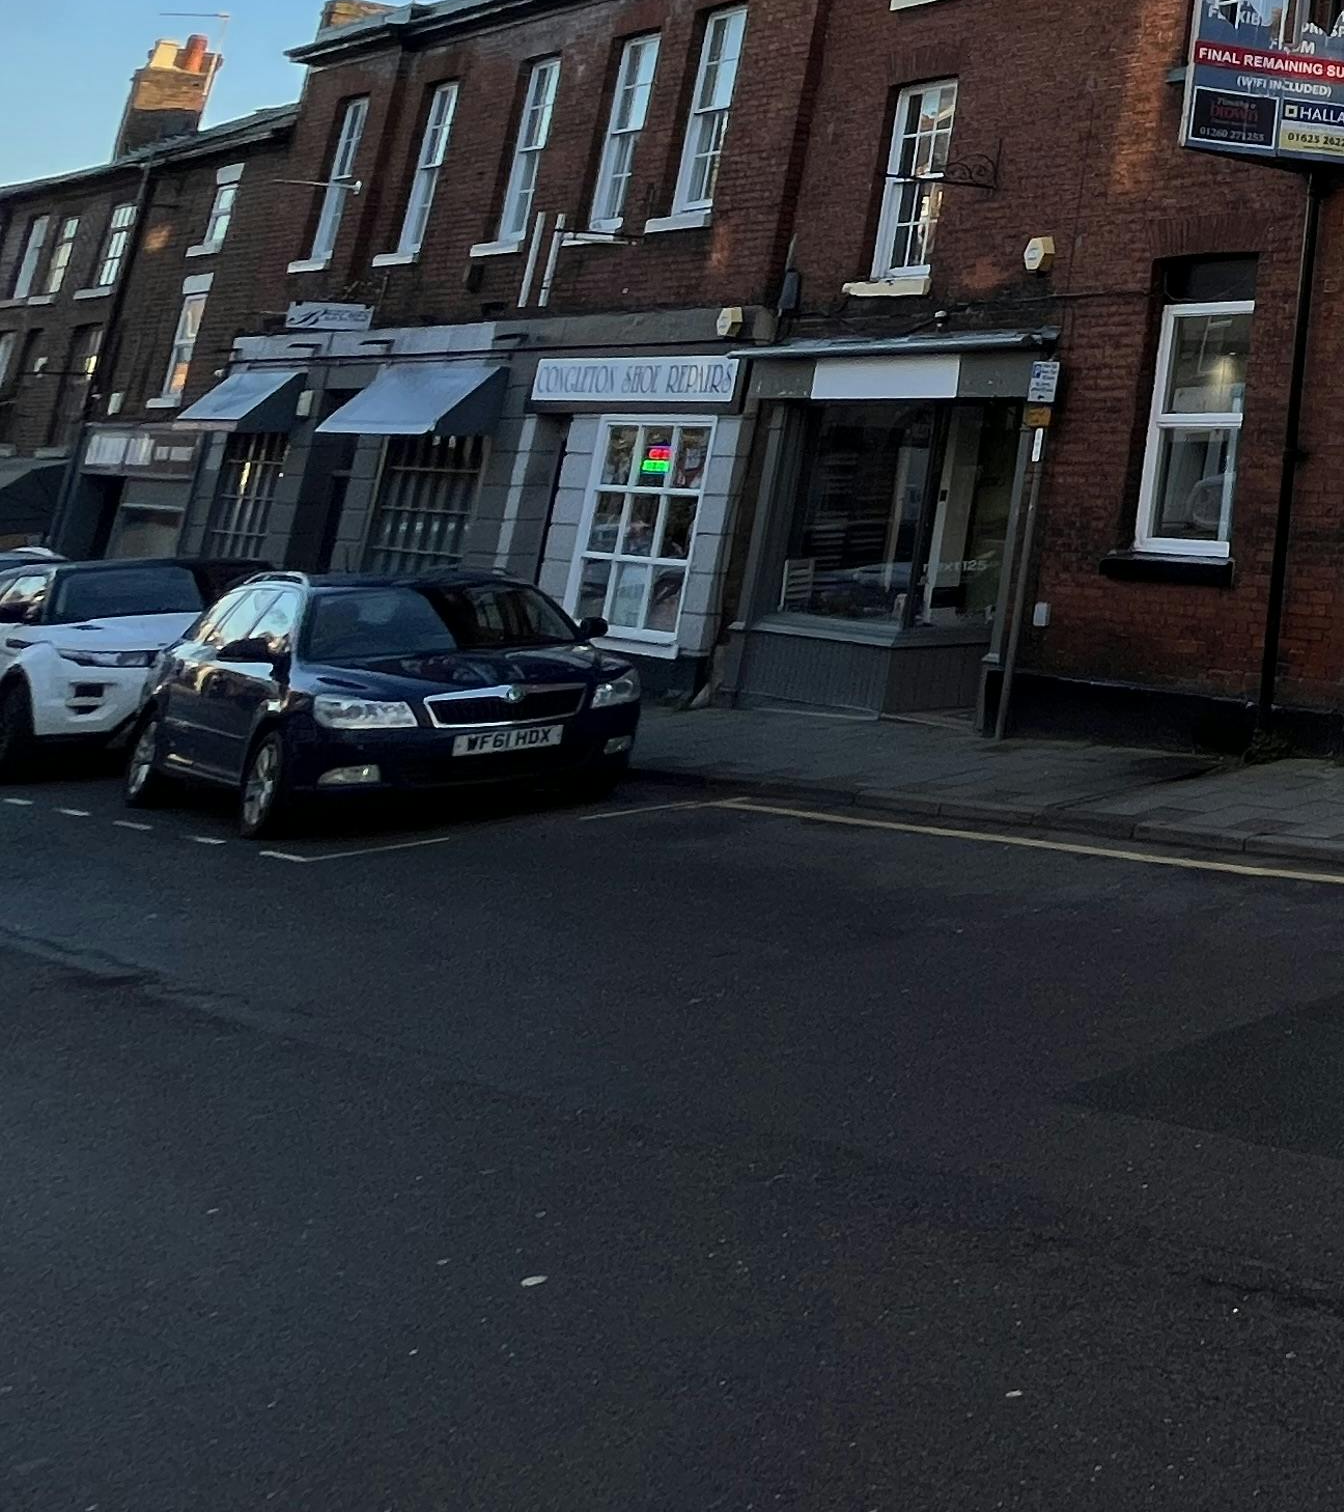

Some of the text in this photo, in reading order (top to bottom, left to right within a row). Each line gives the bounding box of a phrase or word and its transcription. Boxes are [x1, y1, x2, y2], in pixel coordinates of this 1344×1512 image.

[1198, 47, 1240, 65] FINAL
[1243, 54, 1324, 76] REMAINING
[1287, 132, 1320, 144] 01625
[537, 363, 734, 394] CONGLETON SHOE REPAIRS
[466, 727, 553, 751] WF61 HDX
